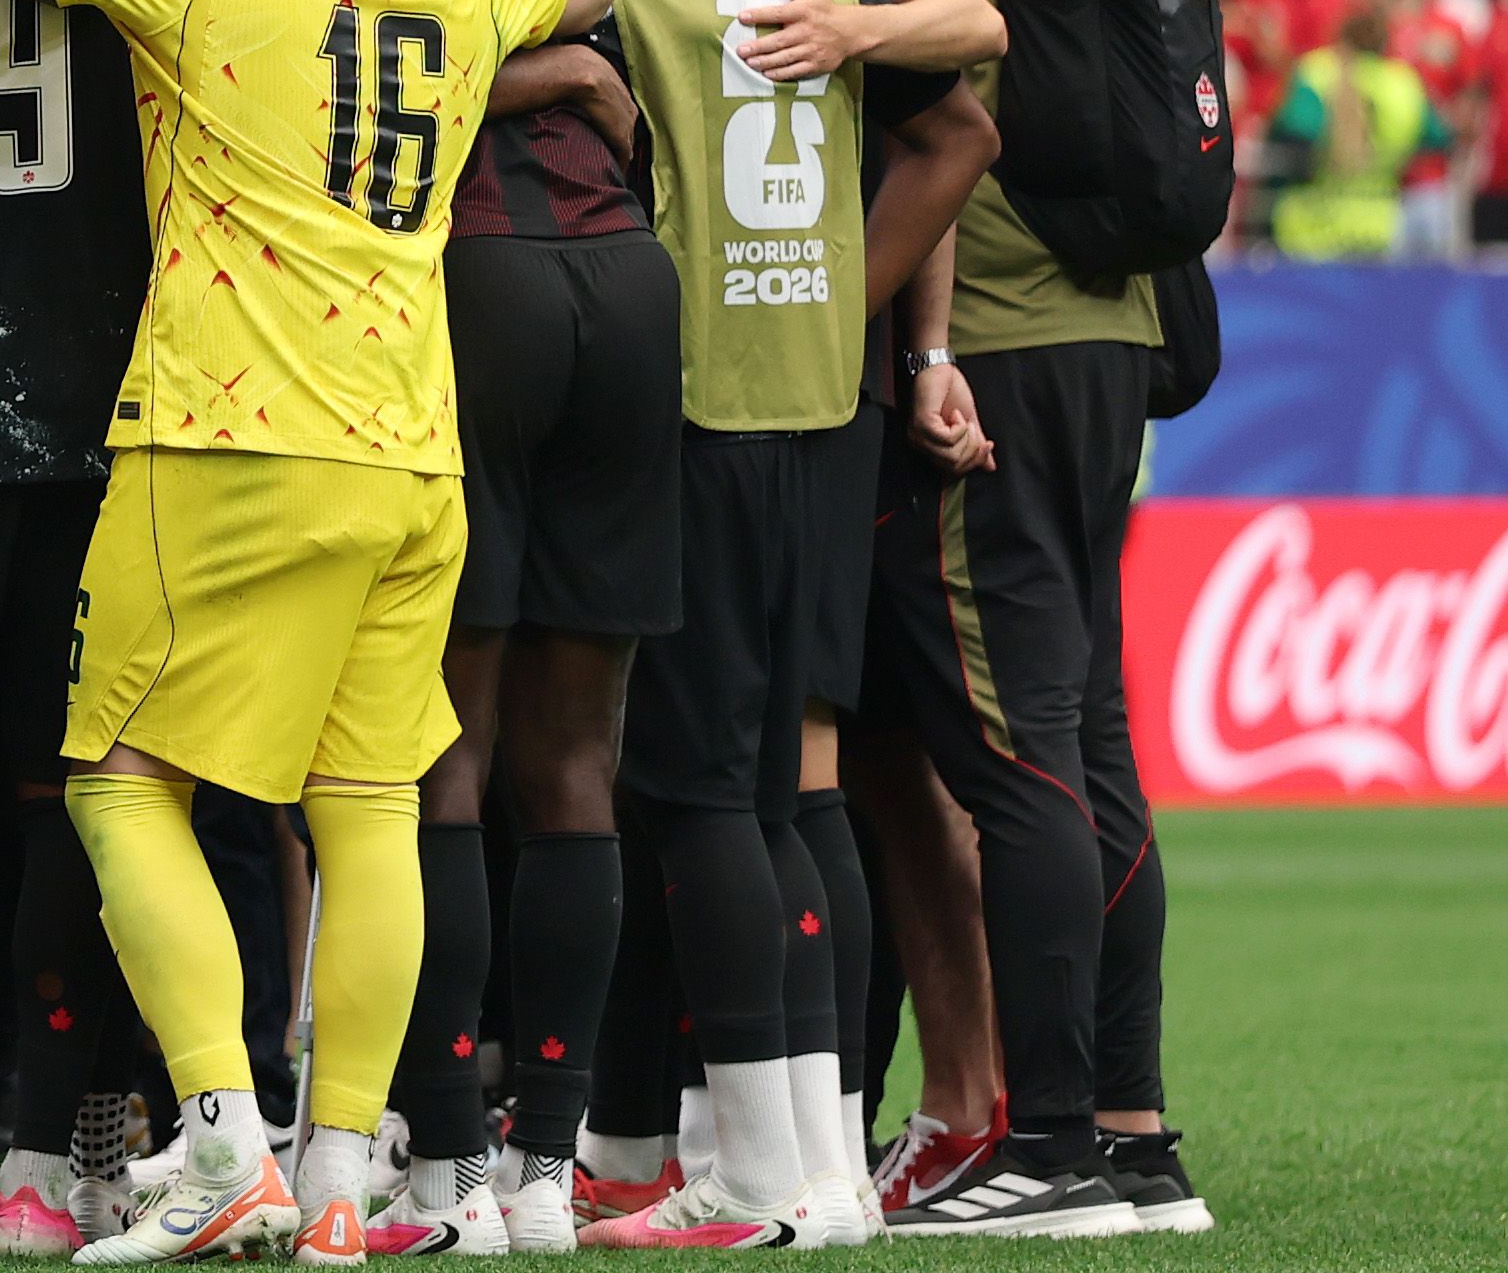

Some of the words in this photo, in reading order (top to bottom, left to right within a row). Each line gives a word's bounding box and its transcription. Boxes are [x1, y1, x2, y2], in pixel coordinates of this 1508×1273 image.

[317, 4, 446, 236] 16
[762, 178, 806, 205] FIFA
[723, 241, 802, 264] WORLD
[803, 238, 824, 262] CUP
[723, 266, 830, 306] 2026
